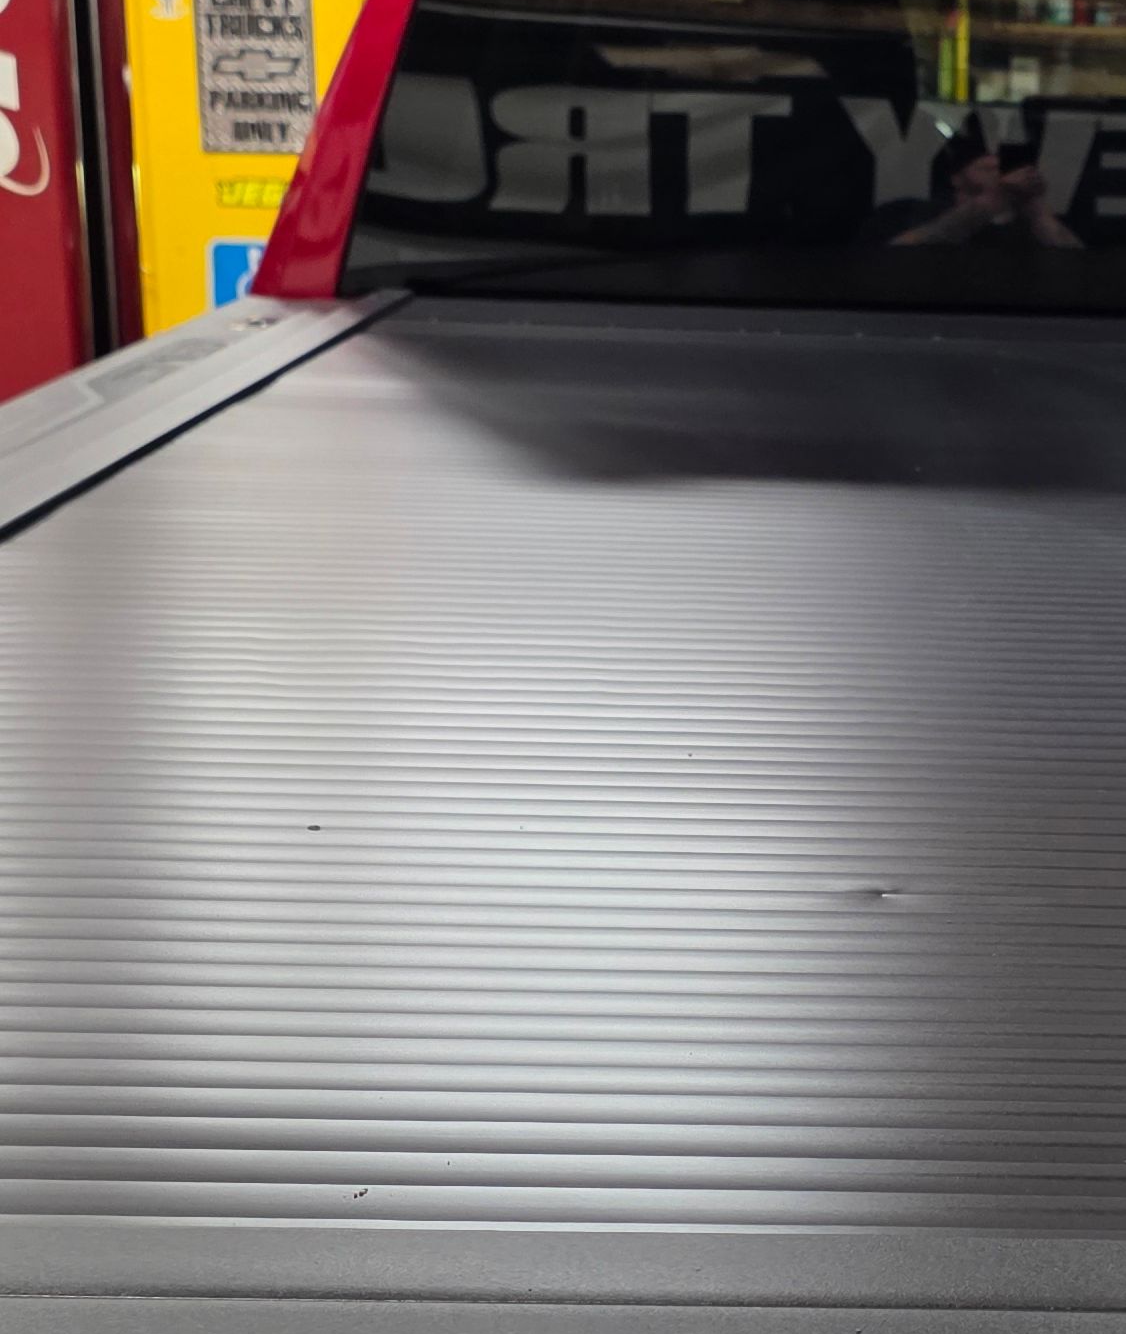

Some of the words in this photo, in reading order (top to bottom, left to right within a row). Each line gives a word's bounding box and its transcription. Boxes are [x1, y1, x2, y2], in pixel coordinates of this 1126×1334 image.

[206, 14, 303, 39] TRUCKS
[209, 91, 312, 114] PARKING
[233, 120, 290, 143] ONLY
